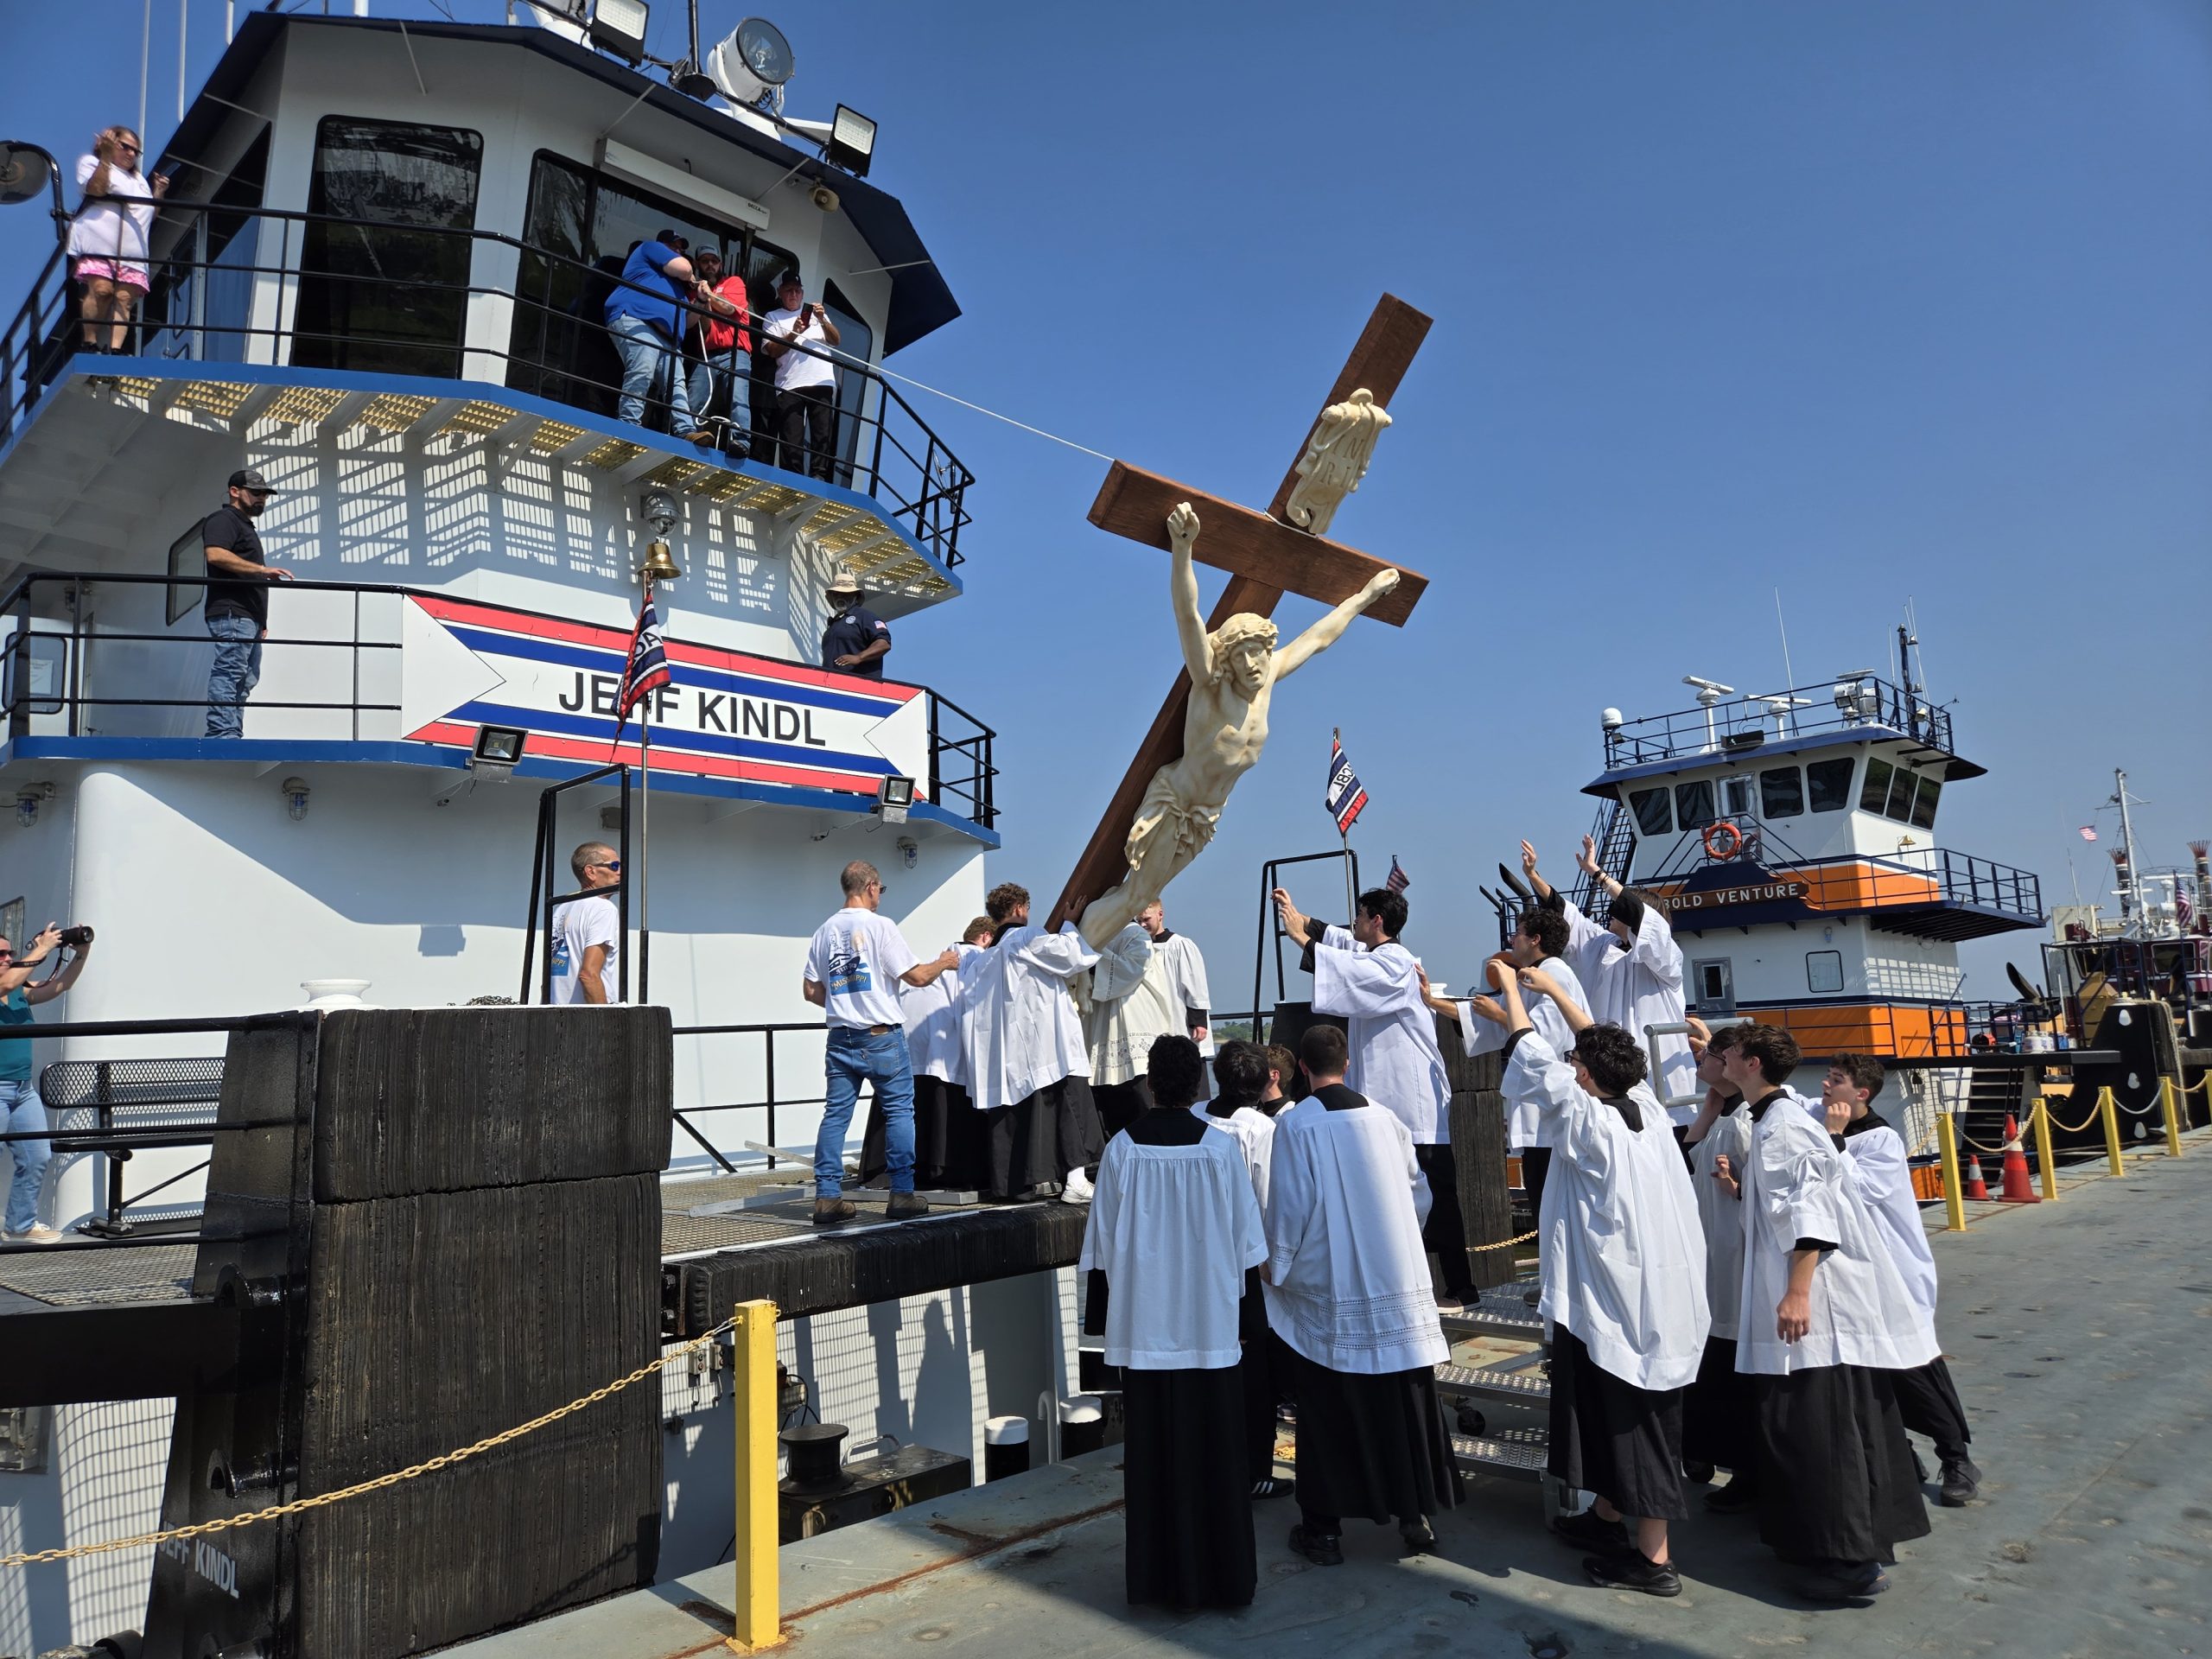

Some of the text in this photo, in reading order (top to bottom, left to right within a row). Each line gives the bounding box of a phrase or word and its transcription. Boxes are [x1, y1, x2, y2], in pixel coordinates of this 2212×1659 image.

[698, 691, 826, 747] KINDL
[1716, 883, 1799, 905] VENTURE
[194, 1538, 239, 1599] KINDL
